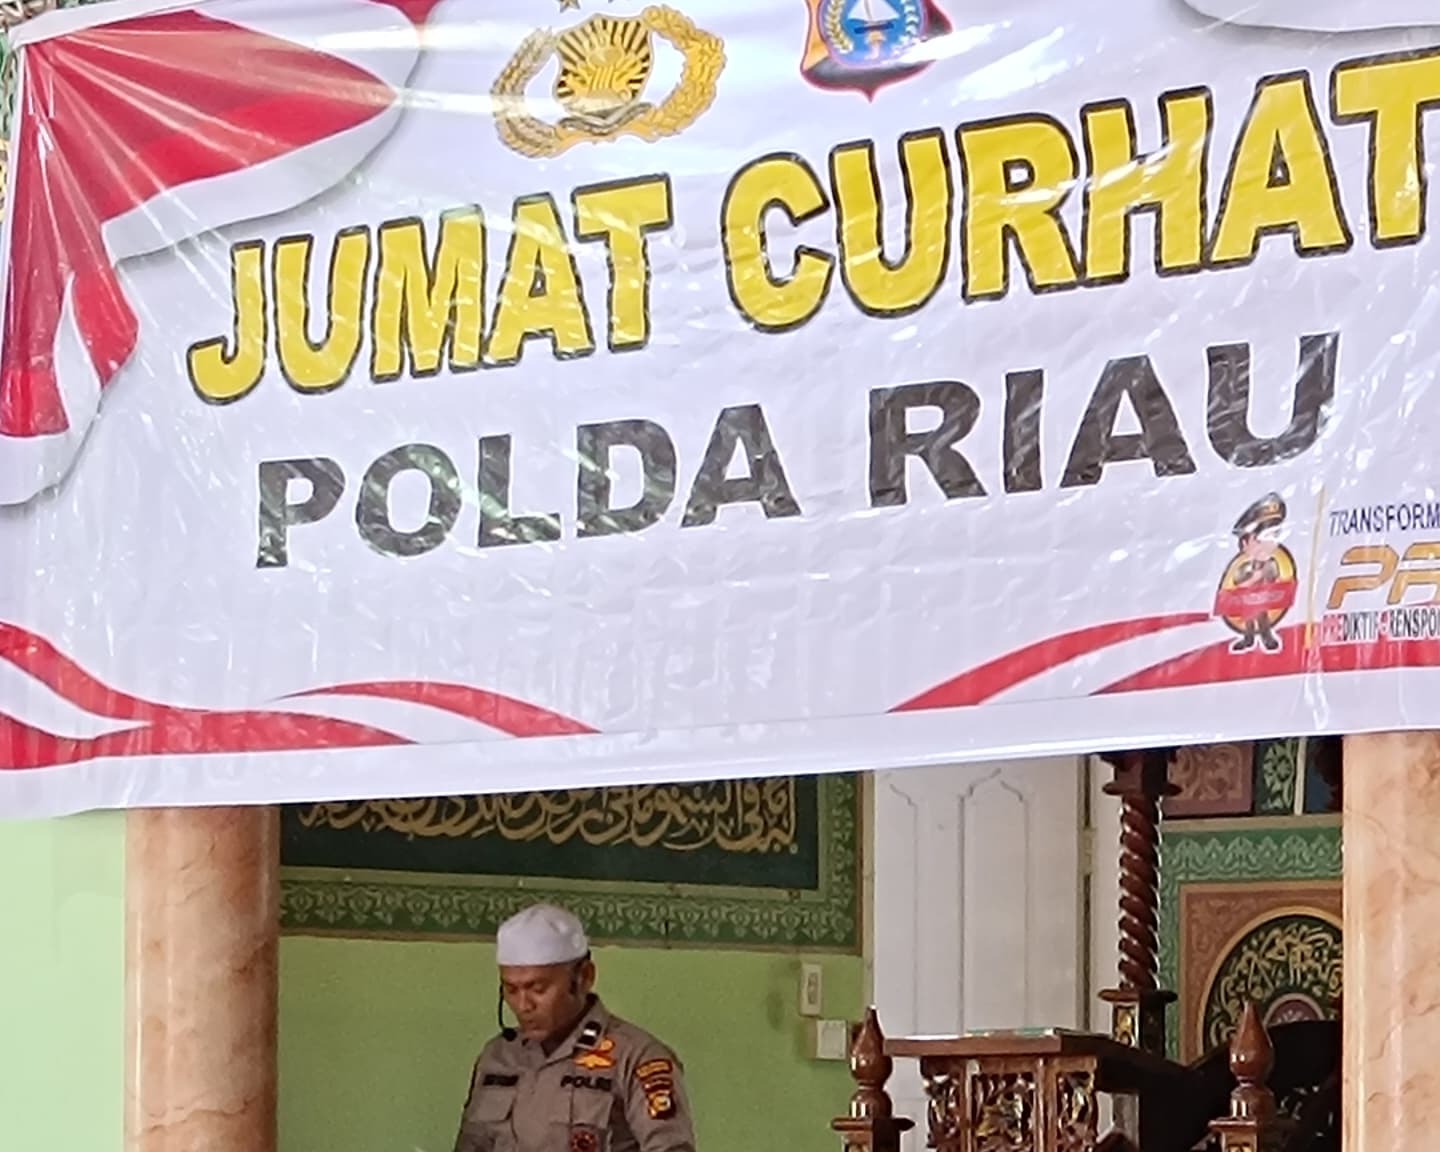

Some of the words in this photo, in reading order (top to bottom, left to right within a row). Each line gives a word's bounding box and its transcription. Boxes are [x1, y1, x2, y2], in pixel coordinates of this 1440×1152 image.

[188, 173, 672, 405] JUMAT
[256, 404, 802, 568] POLDA
[866, 334, 1341, 509] RIAU
